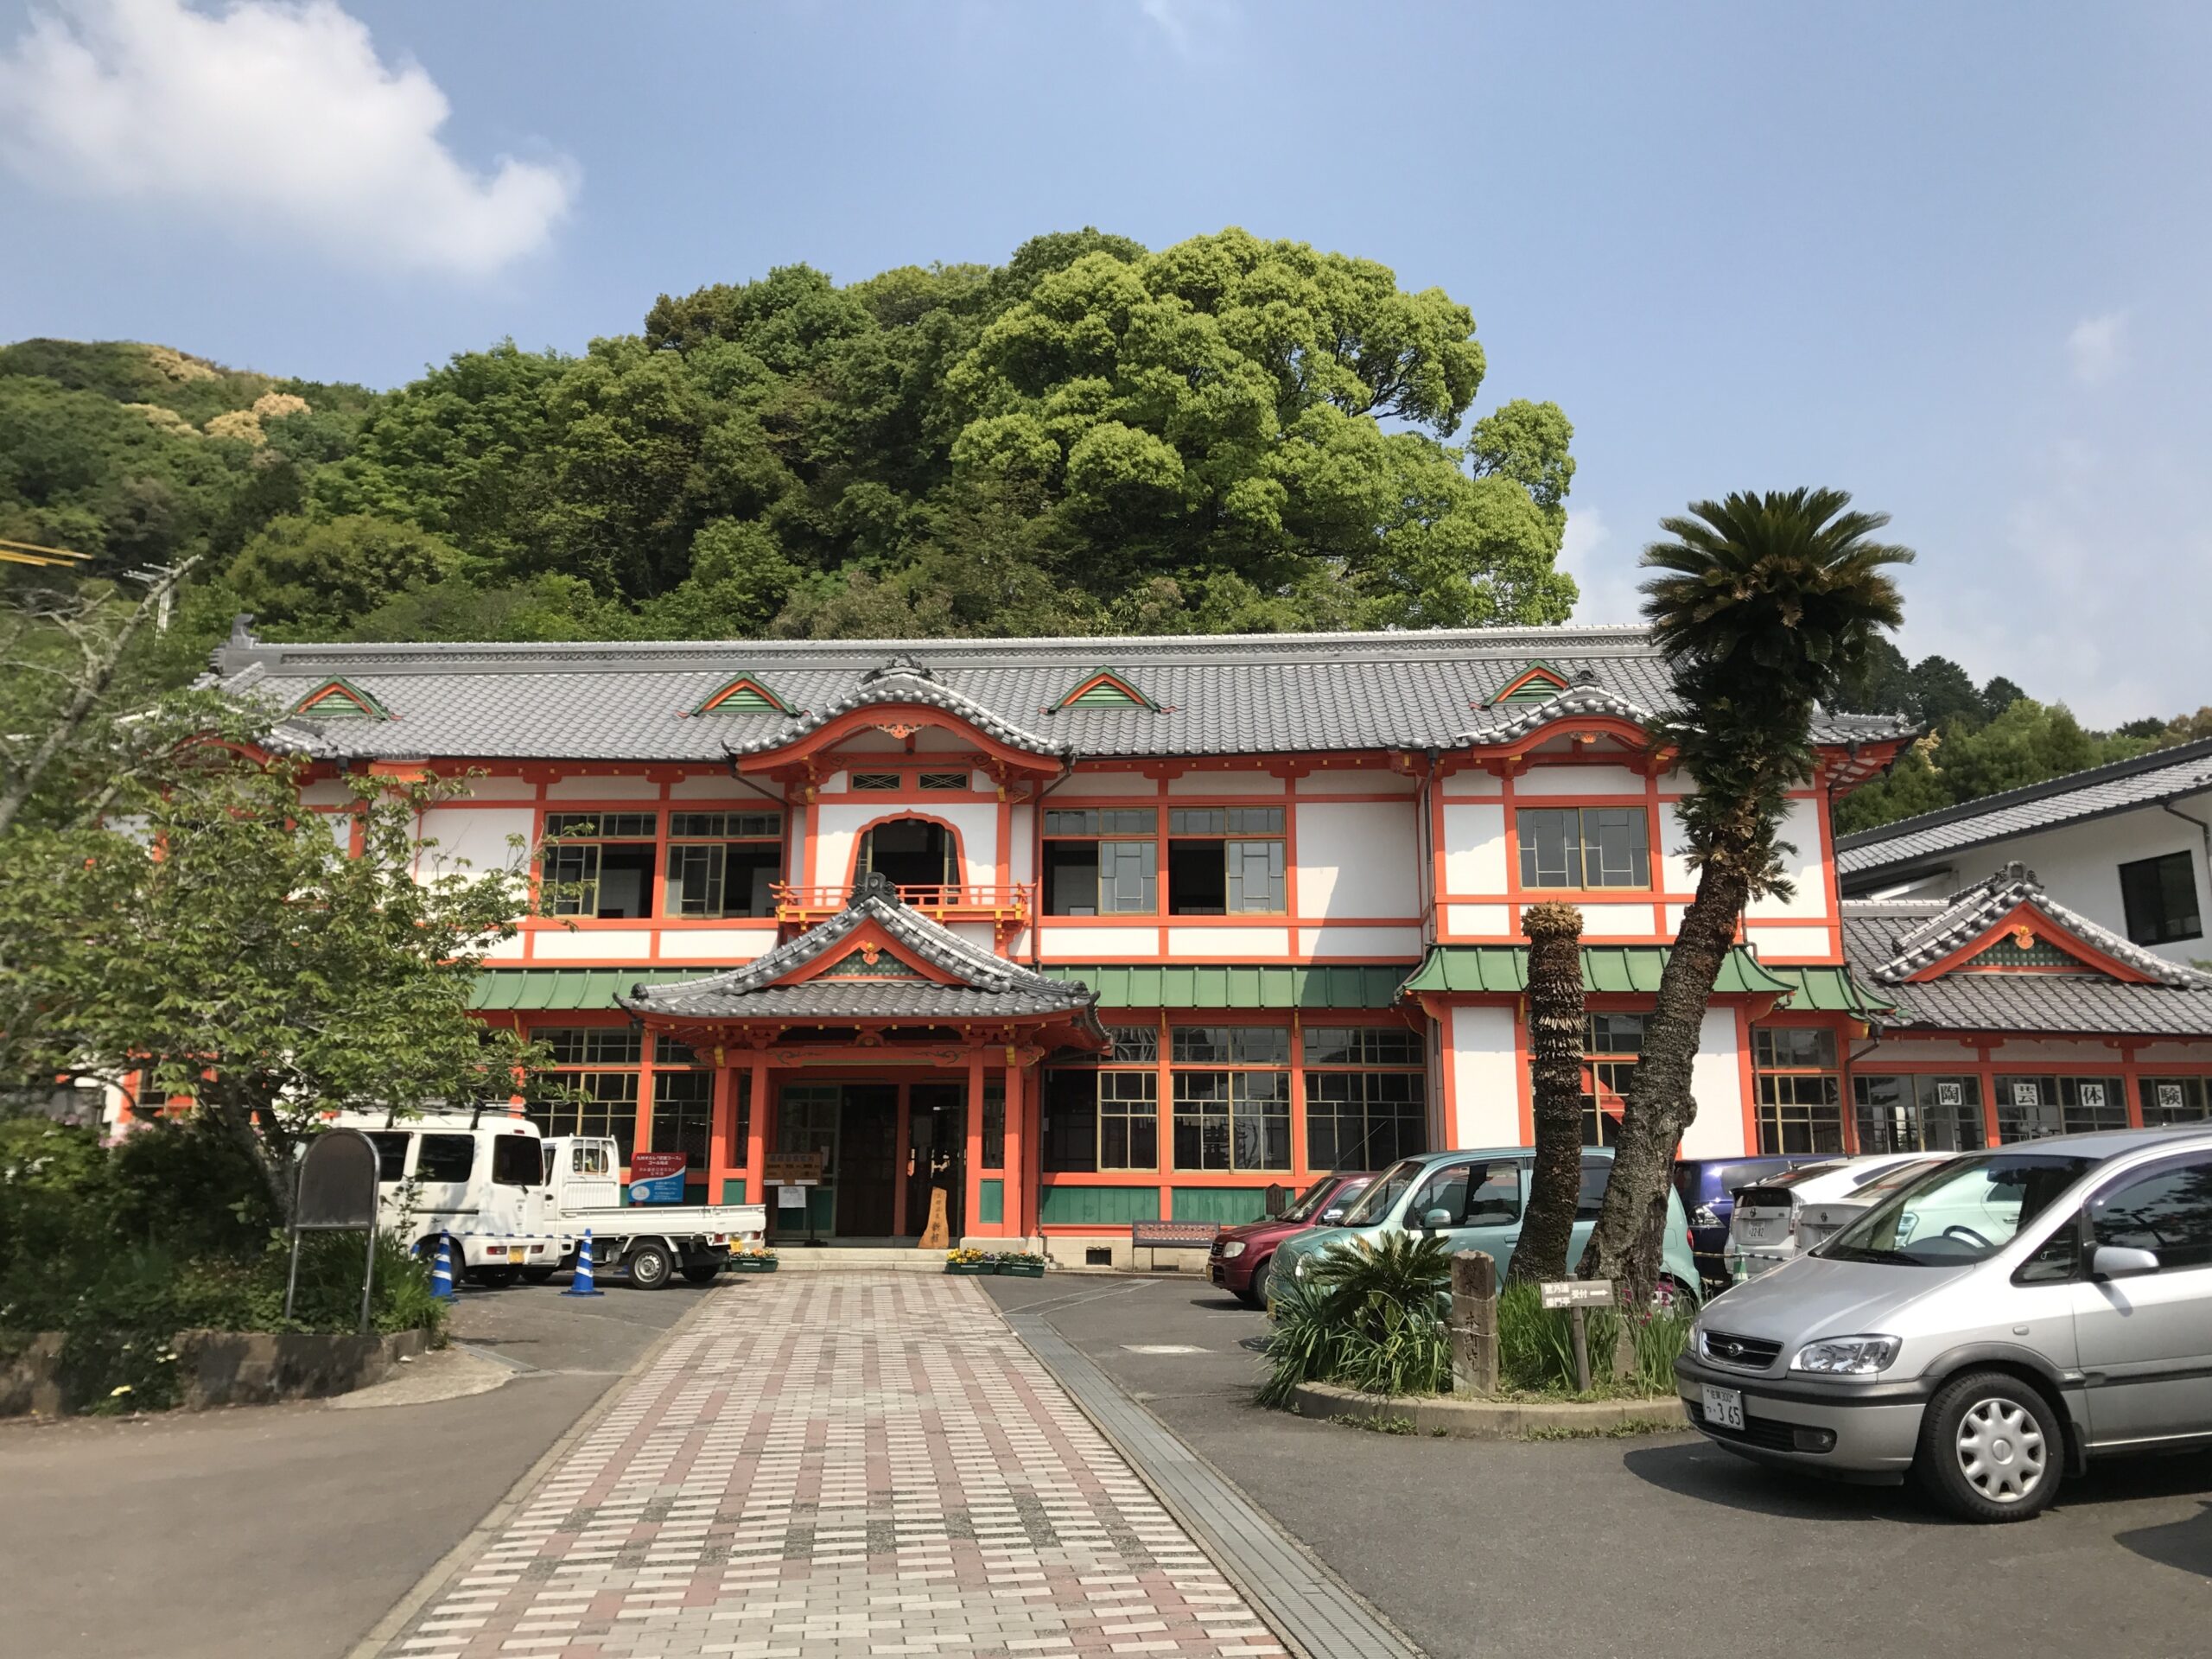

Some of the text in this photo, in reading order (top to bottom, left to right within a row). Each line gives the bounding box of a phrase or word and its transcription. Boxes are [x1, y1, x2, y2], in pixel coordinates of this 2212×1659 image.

[1941, 1084, 2180, 1106] 陶 芸 体 験
